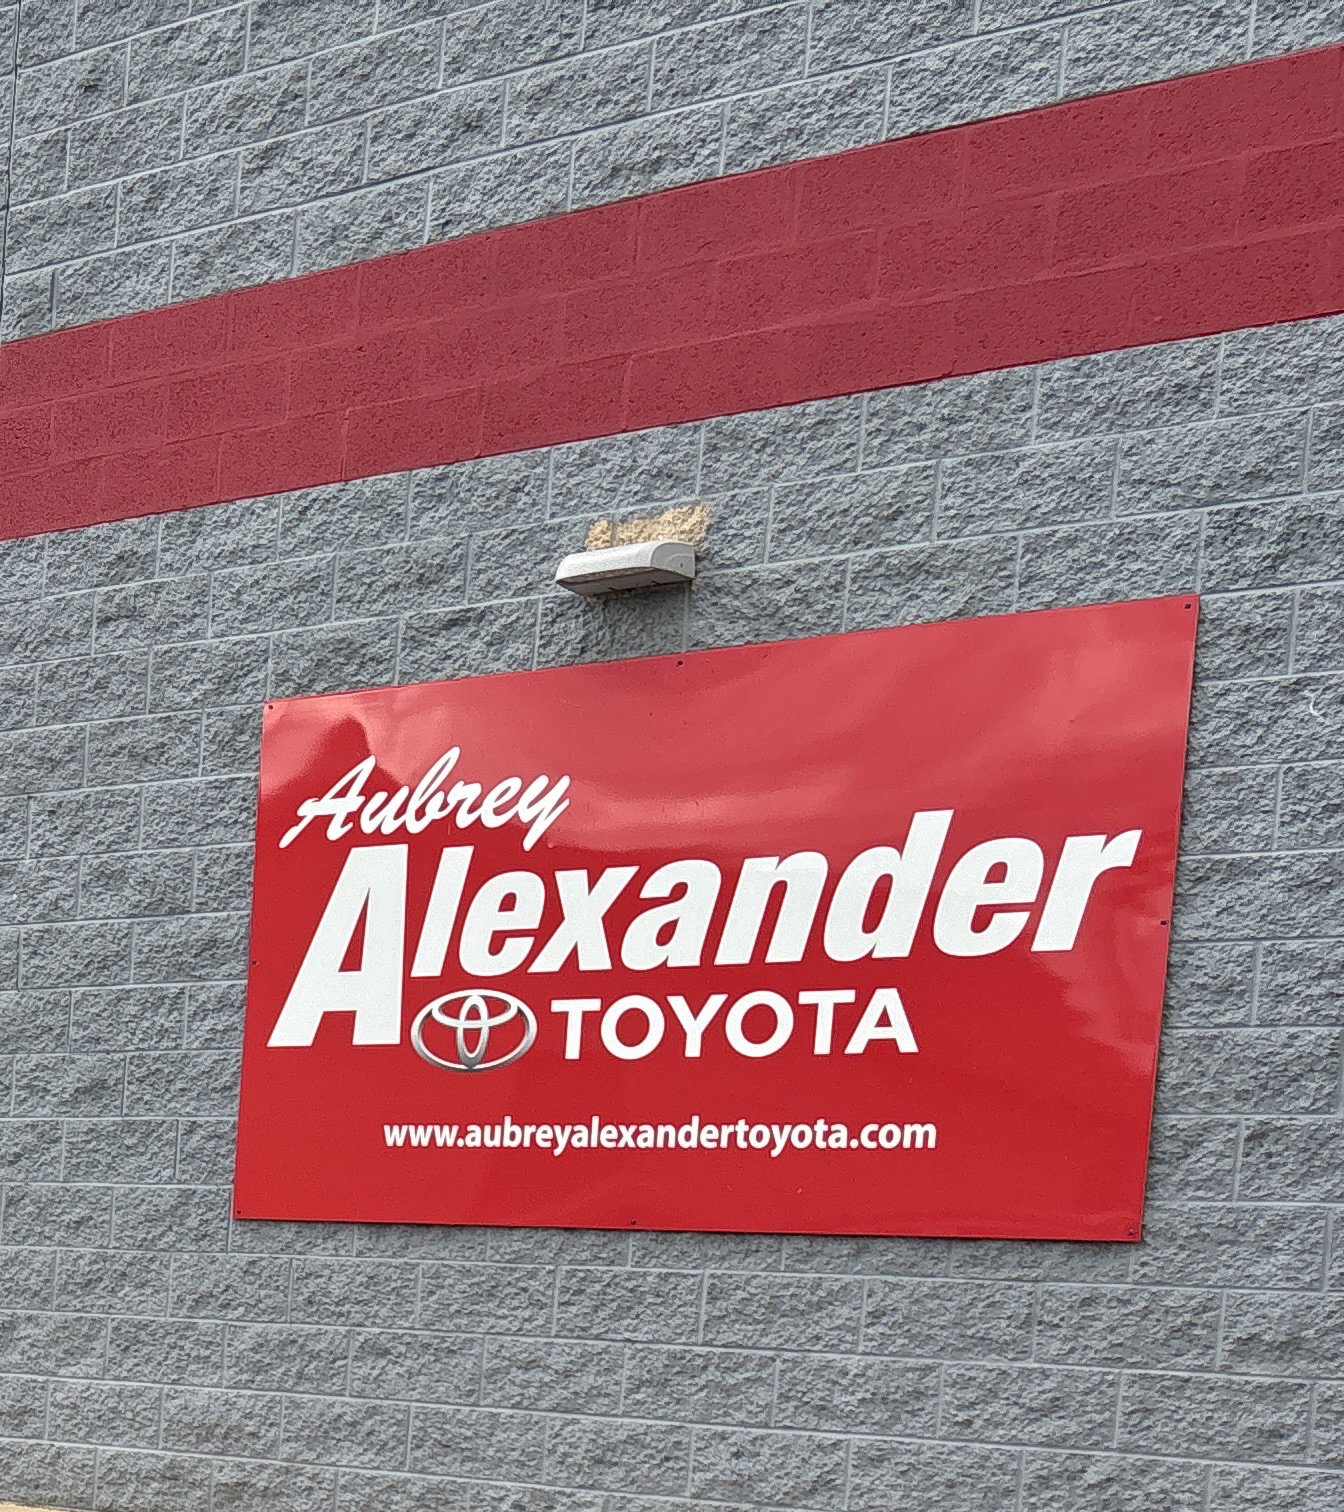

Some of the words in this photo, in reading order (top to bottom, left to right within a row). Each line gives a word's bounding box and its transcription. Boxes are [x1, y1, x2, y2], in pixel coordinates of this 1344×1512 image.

[277, 746, 571, 852] Aubrey
[267, 810, 1142, 1047] Alexander
[550, 987, 918, 1060] TOYOTA
[383, 1115, 937, 1158] www.aubreyalexandertoyota.com
